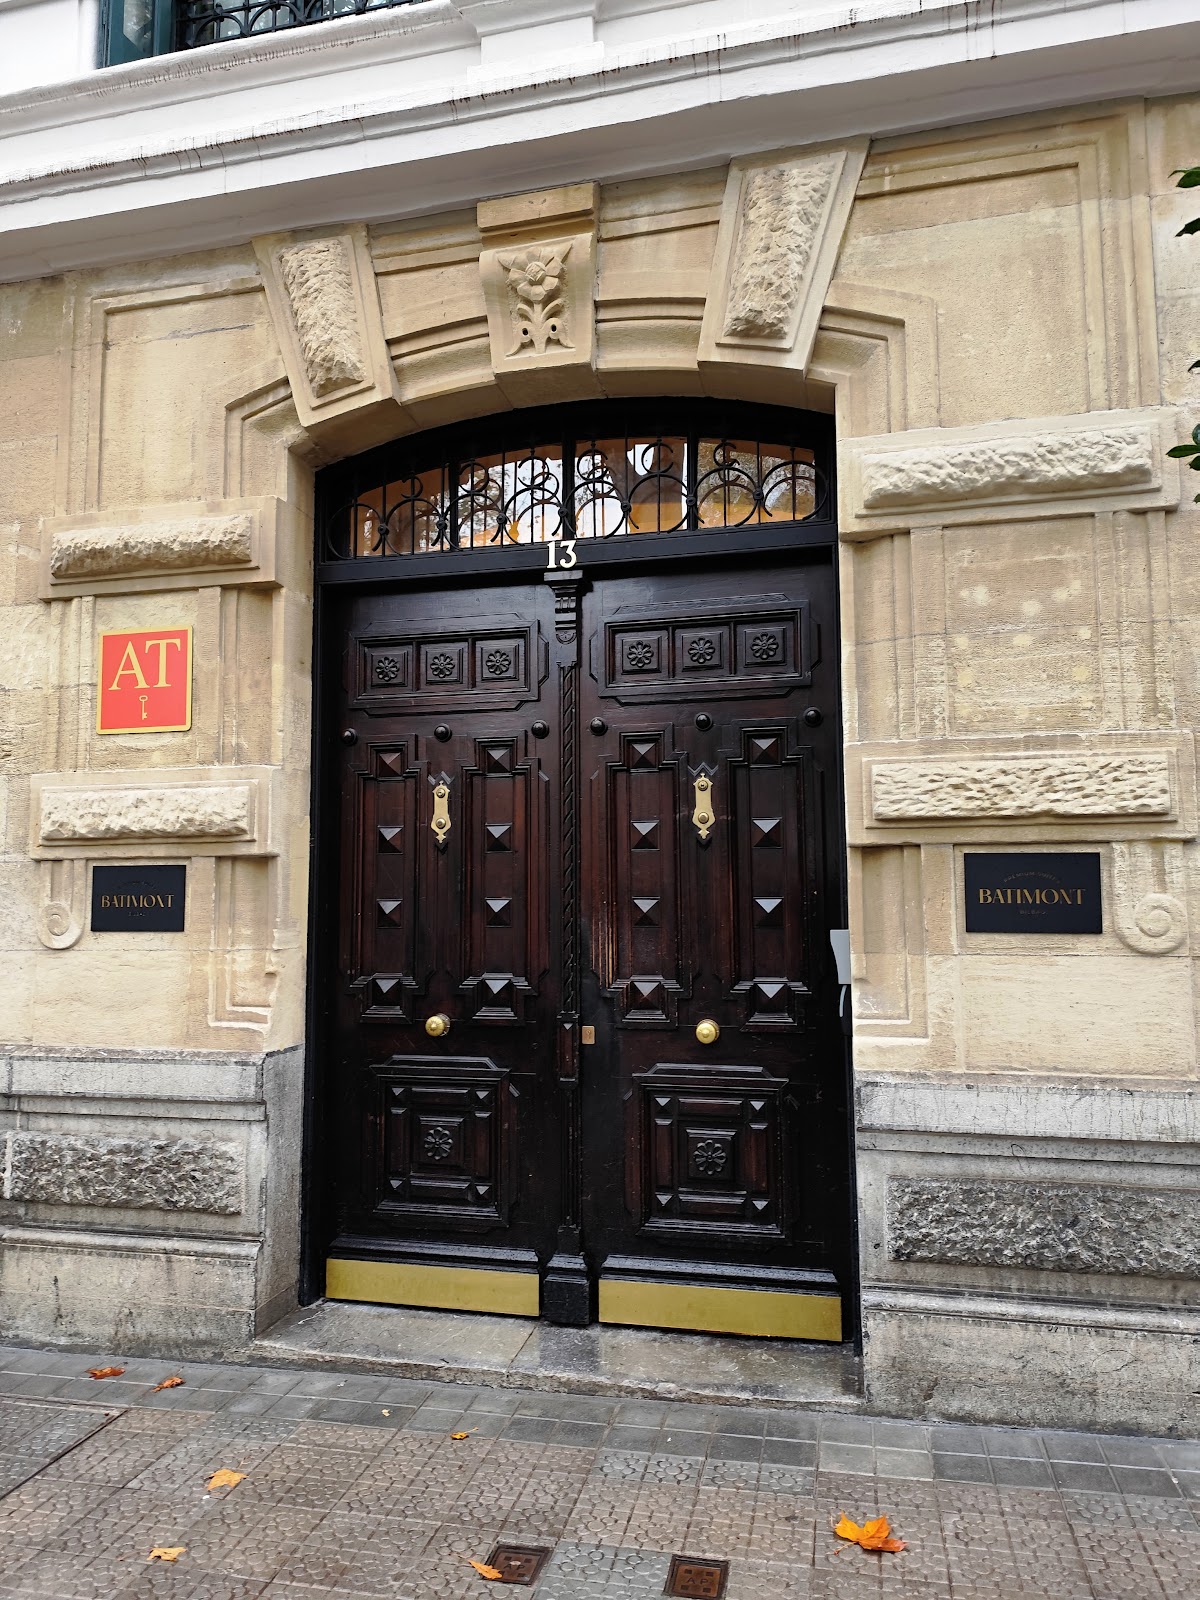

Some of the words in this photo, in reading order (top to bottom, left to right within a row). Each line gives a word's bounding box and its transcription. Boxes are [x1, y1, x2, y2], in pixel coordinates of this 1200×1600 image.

[547, 540, 577, 569] 13
[108, 638, 181, 691] AT
[101, 894, 175, 908] BATIMONT
[979, 888, 1086, 905] BATIMONT
